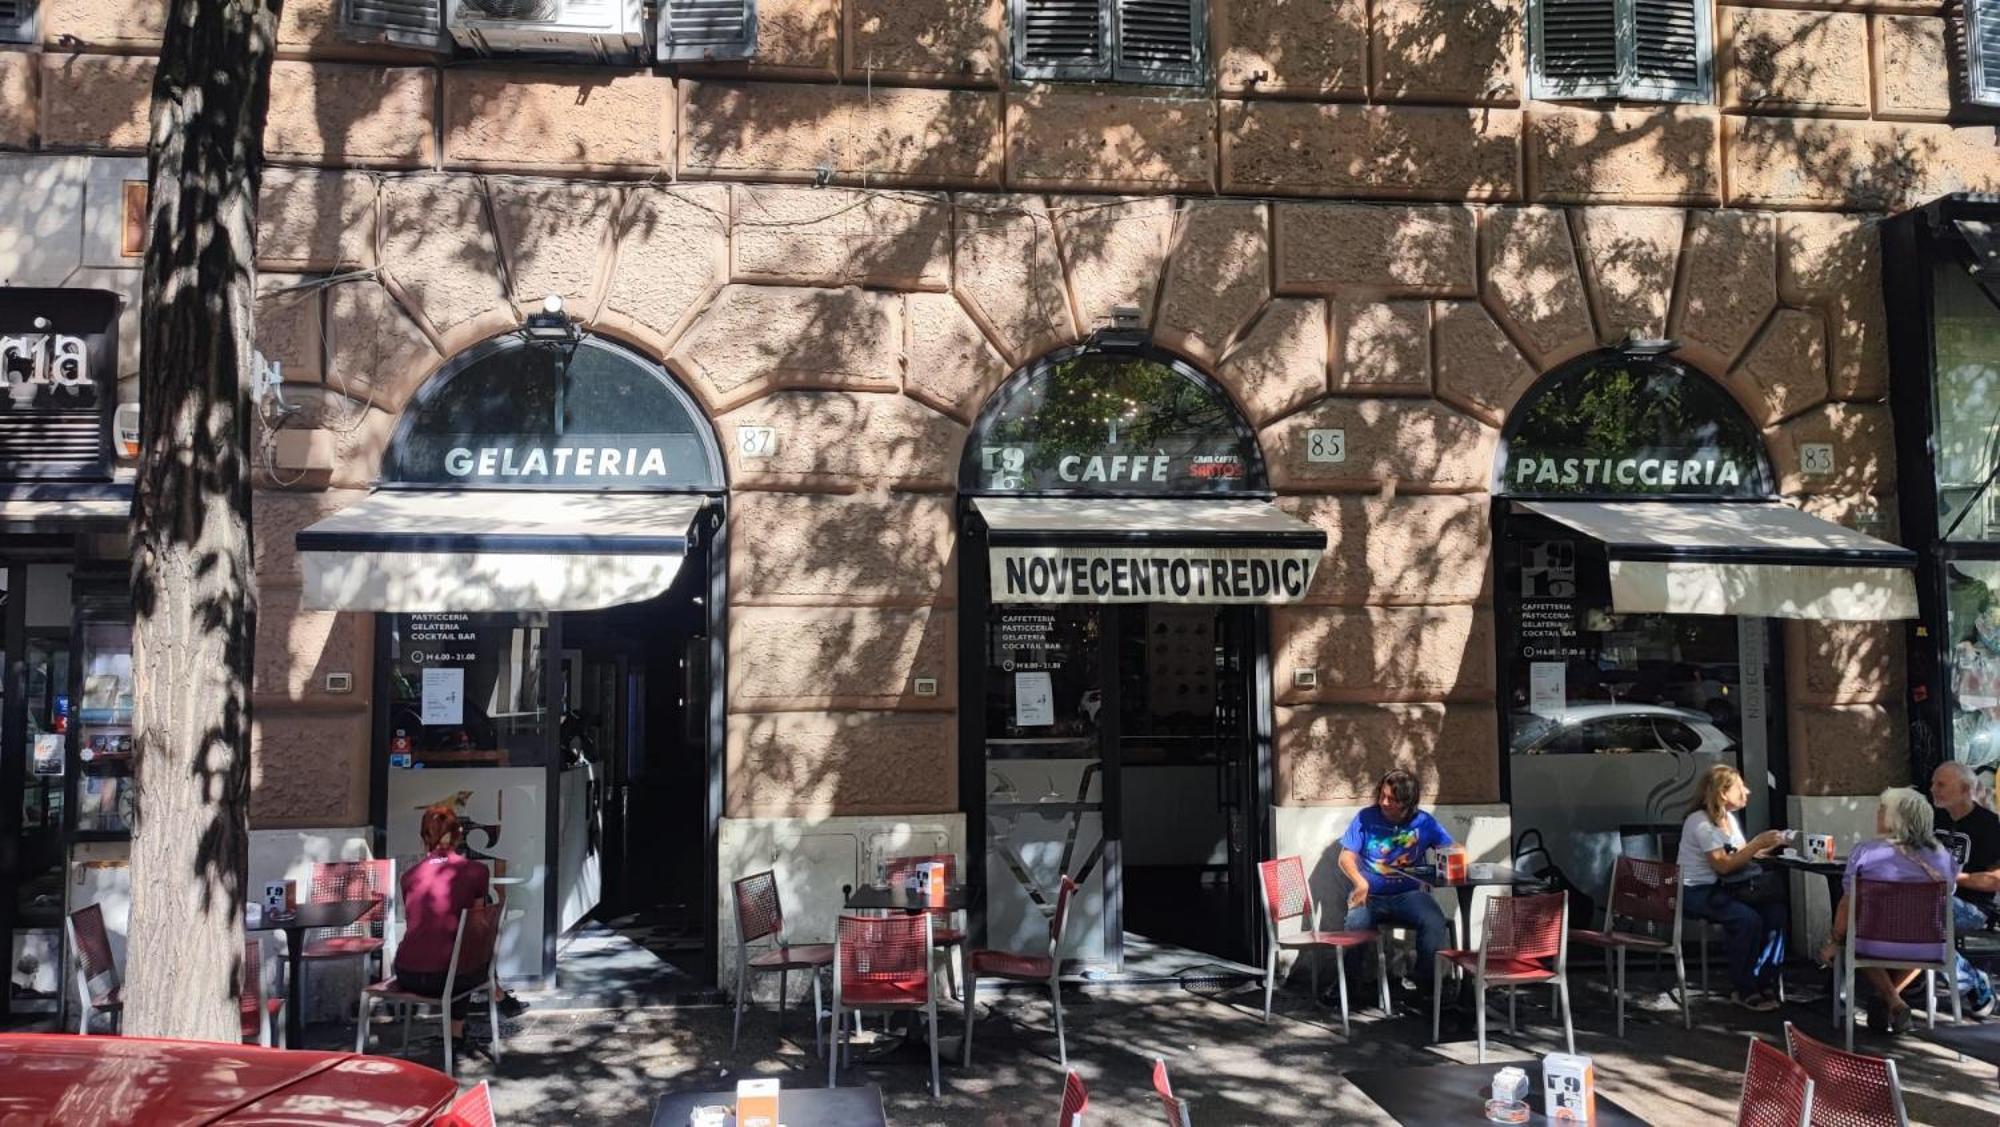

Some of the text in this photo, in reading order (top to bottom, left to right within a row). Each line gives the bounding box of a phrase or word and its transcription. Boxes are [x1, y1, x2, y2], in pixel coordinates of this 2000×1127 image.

[743, 429, 770, 452] 87
[1311, 433, 1340, 456] 85
[444, 447, 667, 477] GELATERIA
[1058, 448, 1170, 482] CAFFÈ
[1805, 447, 1831, 469] 83
[1516, 458, 1740, 486] PASTICCERIA
[1006, 556, 1309, 598] NOVECENTOTREDICI
[411, 623, 460, 631] GELATERIA
